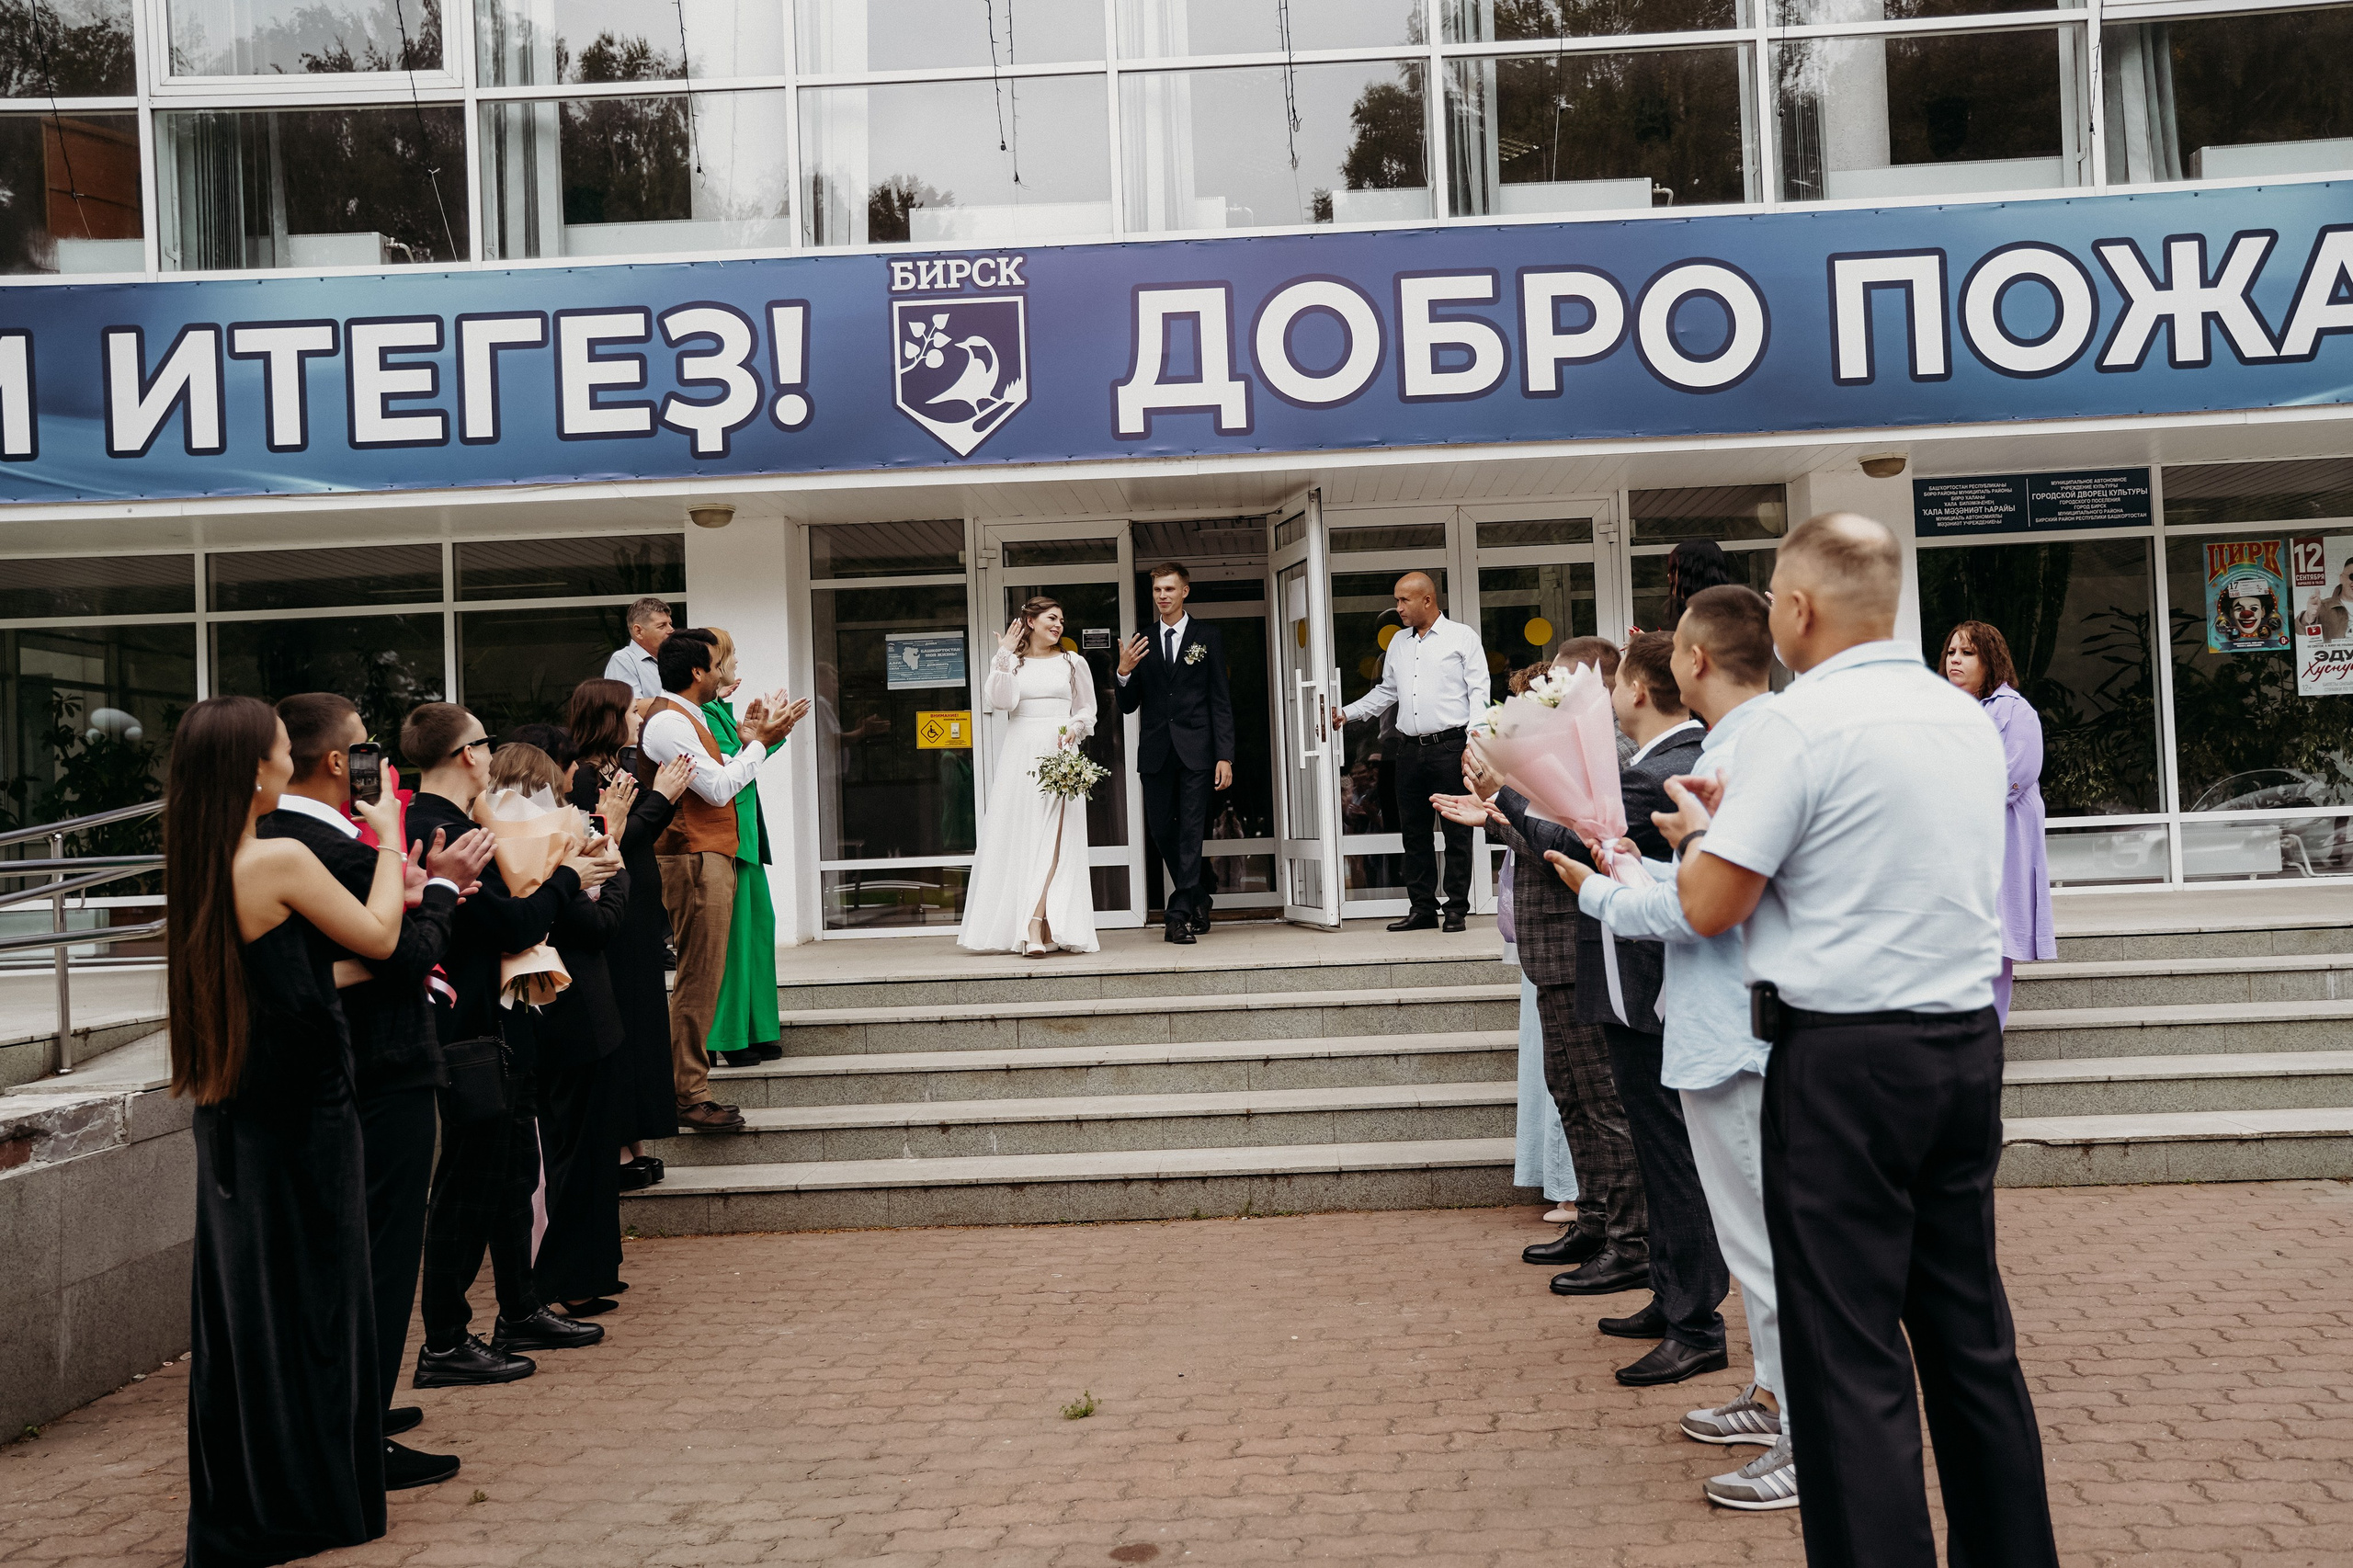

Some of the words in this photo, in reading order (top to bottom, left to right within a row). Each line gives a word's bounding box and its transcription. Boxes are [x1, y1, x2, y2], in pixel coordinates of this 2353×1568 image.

[890, 256, 1026, 293] БИРСК
[1115, 263, 1766, 436] ДОБРО
[106, 303, 813, 455] ИТЕГЕҘ!
[2031, 491, 2076, 500] ГОРОДСКОЙ
[2076, 490, 2108, 499] ДВОРЕЦ
[2109, 487, 2148, 496] КУЛЬТУРЫ
[2206, 540, 2284, 585] ЦИРК
[2294, 542, 2325, 574] 12
[2230, 582, 2239, 590] 17
[2296, 574, 2325, 582] СЕНТЯБРЯ
[2314, 649, 2353, 663] ЭДУ
[2302, 661, 2353, 682] Хусну
